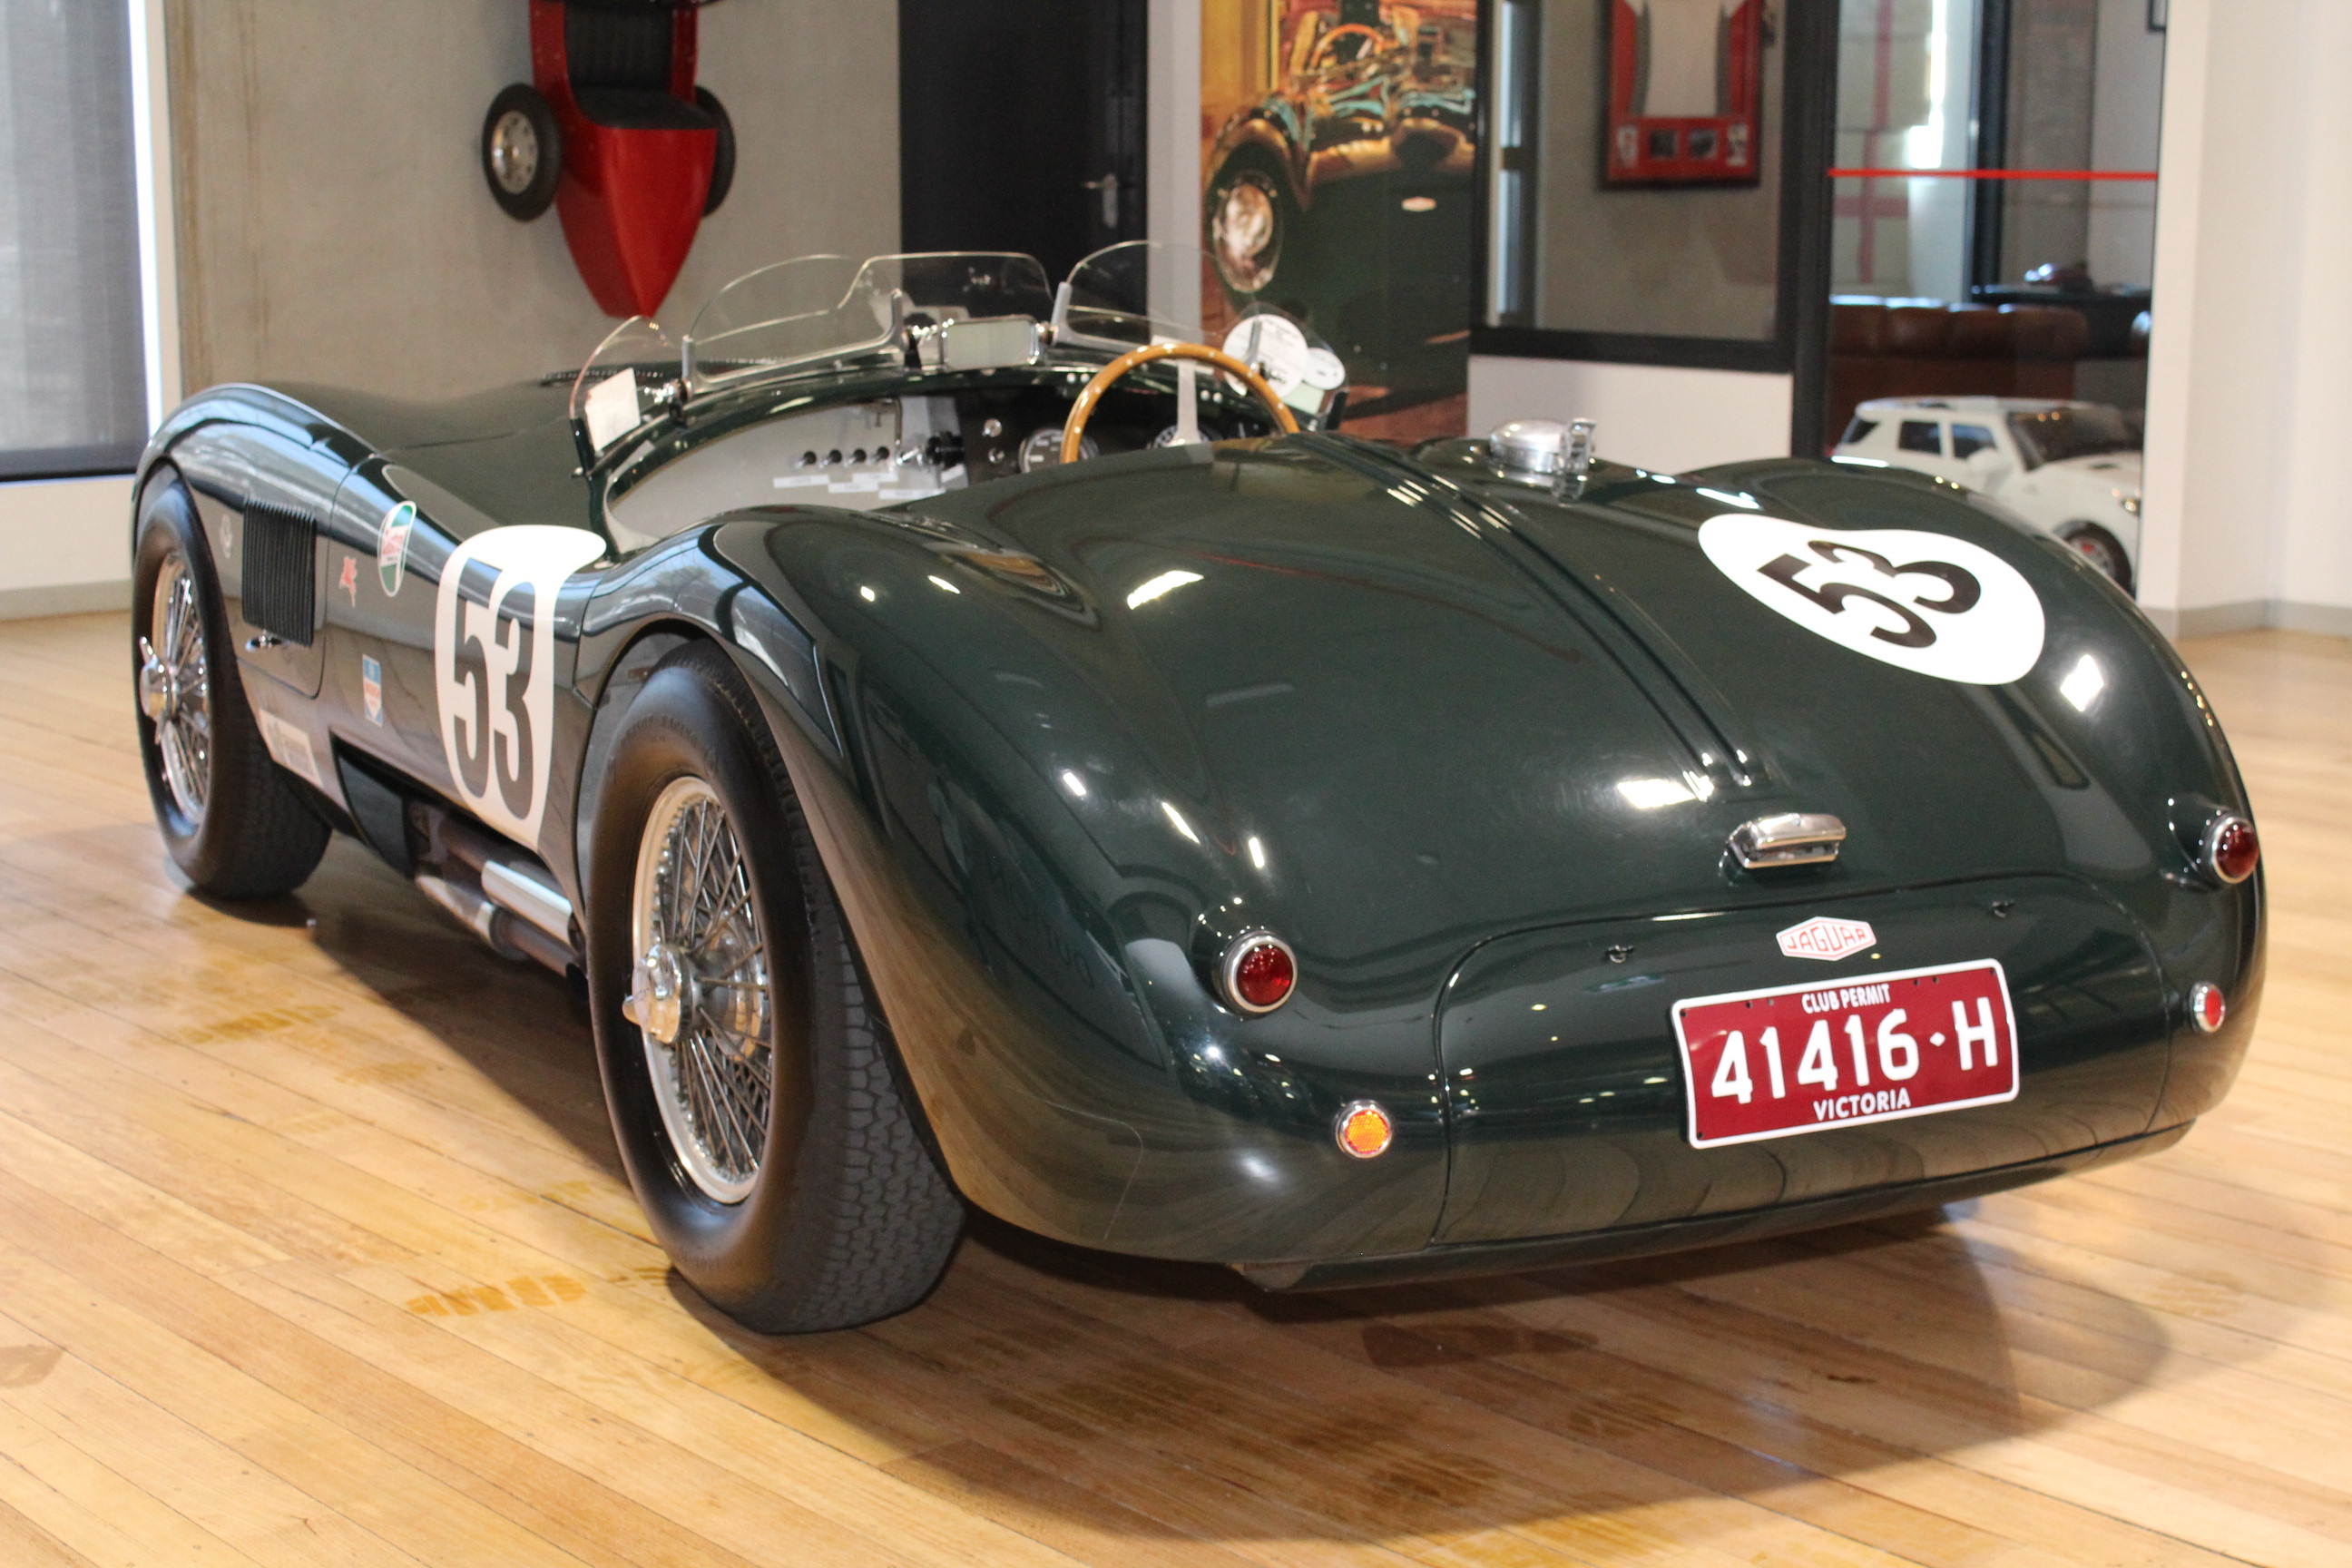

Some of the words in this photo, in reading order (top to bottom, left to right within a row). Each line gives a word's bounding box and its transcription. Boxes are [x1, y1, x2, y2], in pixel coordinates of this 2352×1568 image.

[1756, 540, 1982, 649] 53
[453, 556, 536, 820] 53
[1787, 925, 1867, 952] JAGUAR
[1801, 990, 1840, 1014] CLUB
[1839, 983, 1891, 1009] PERMIT
[1813, 1087, 1912, 1122] VICTORIA
